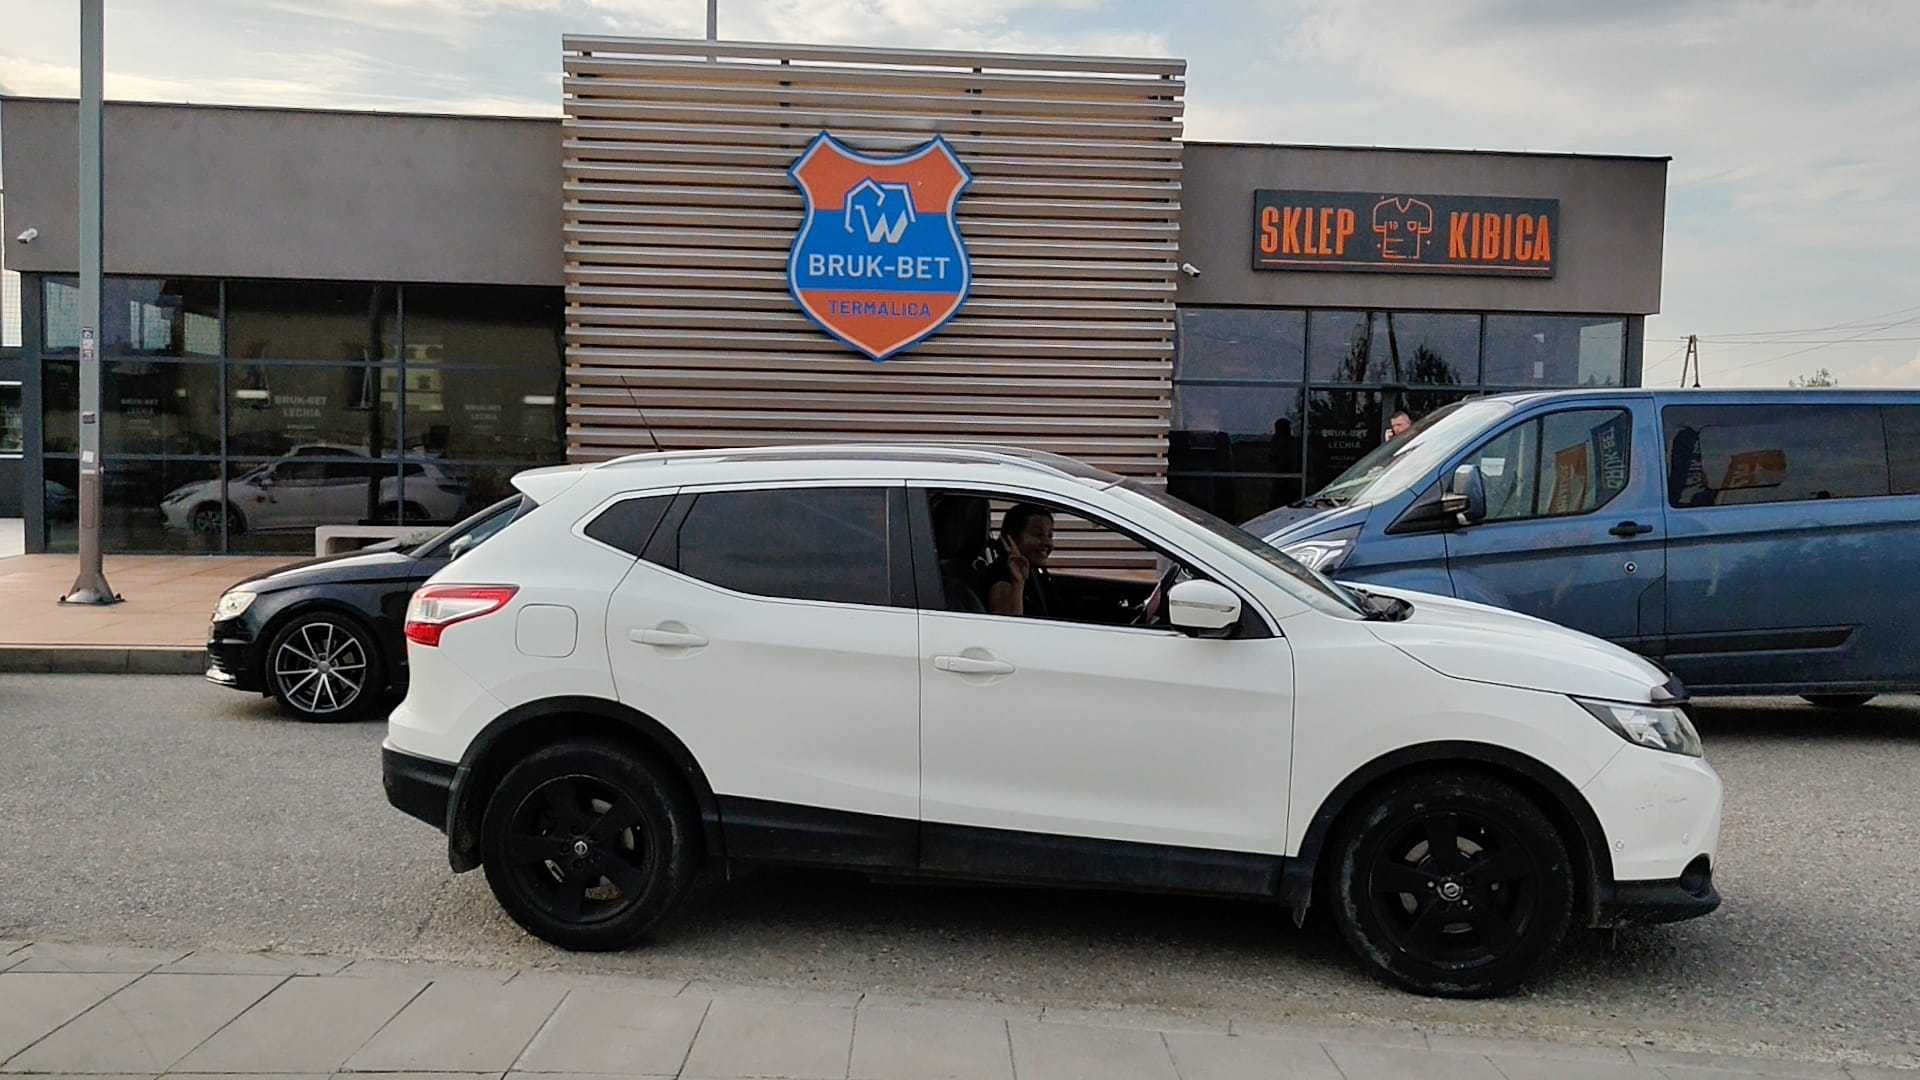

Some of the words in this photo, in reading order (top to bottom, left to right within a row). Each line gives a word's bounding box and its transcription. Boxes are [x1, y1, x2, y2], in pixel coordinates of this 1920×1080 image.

[1260, 206, 1355, 256] SKLEP
[1449, 211, 1551, 262] KIBICA
[808, 253, 951, 280] BRUK-BET
[829, 300, 932, 318] TERMALICA
